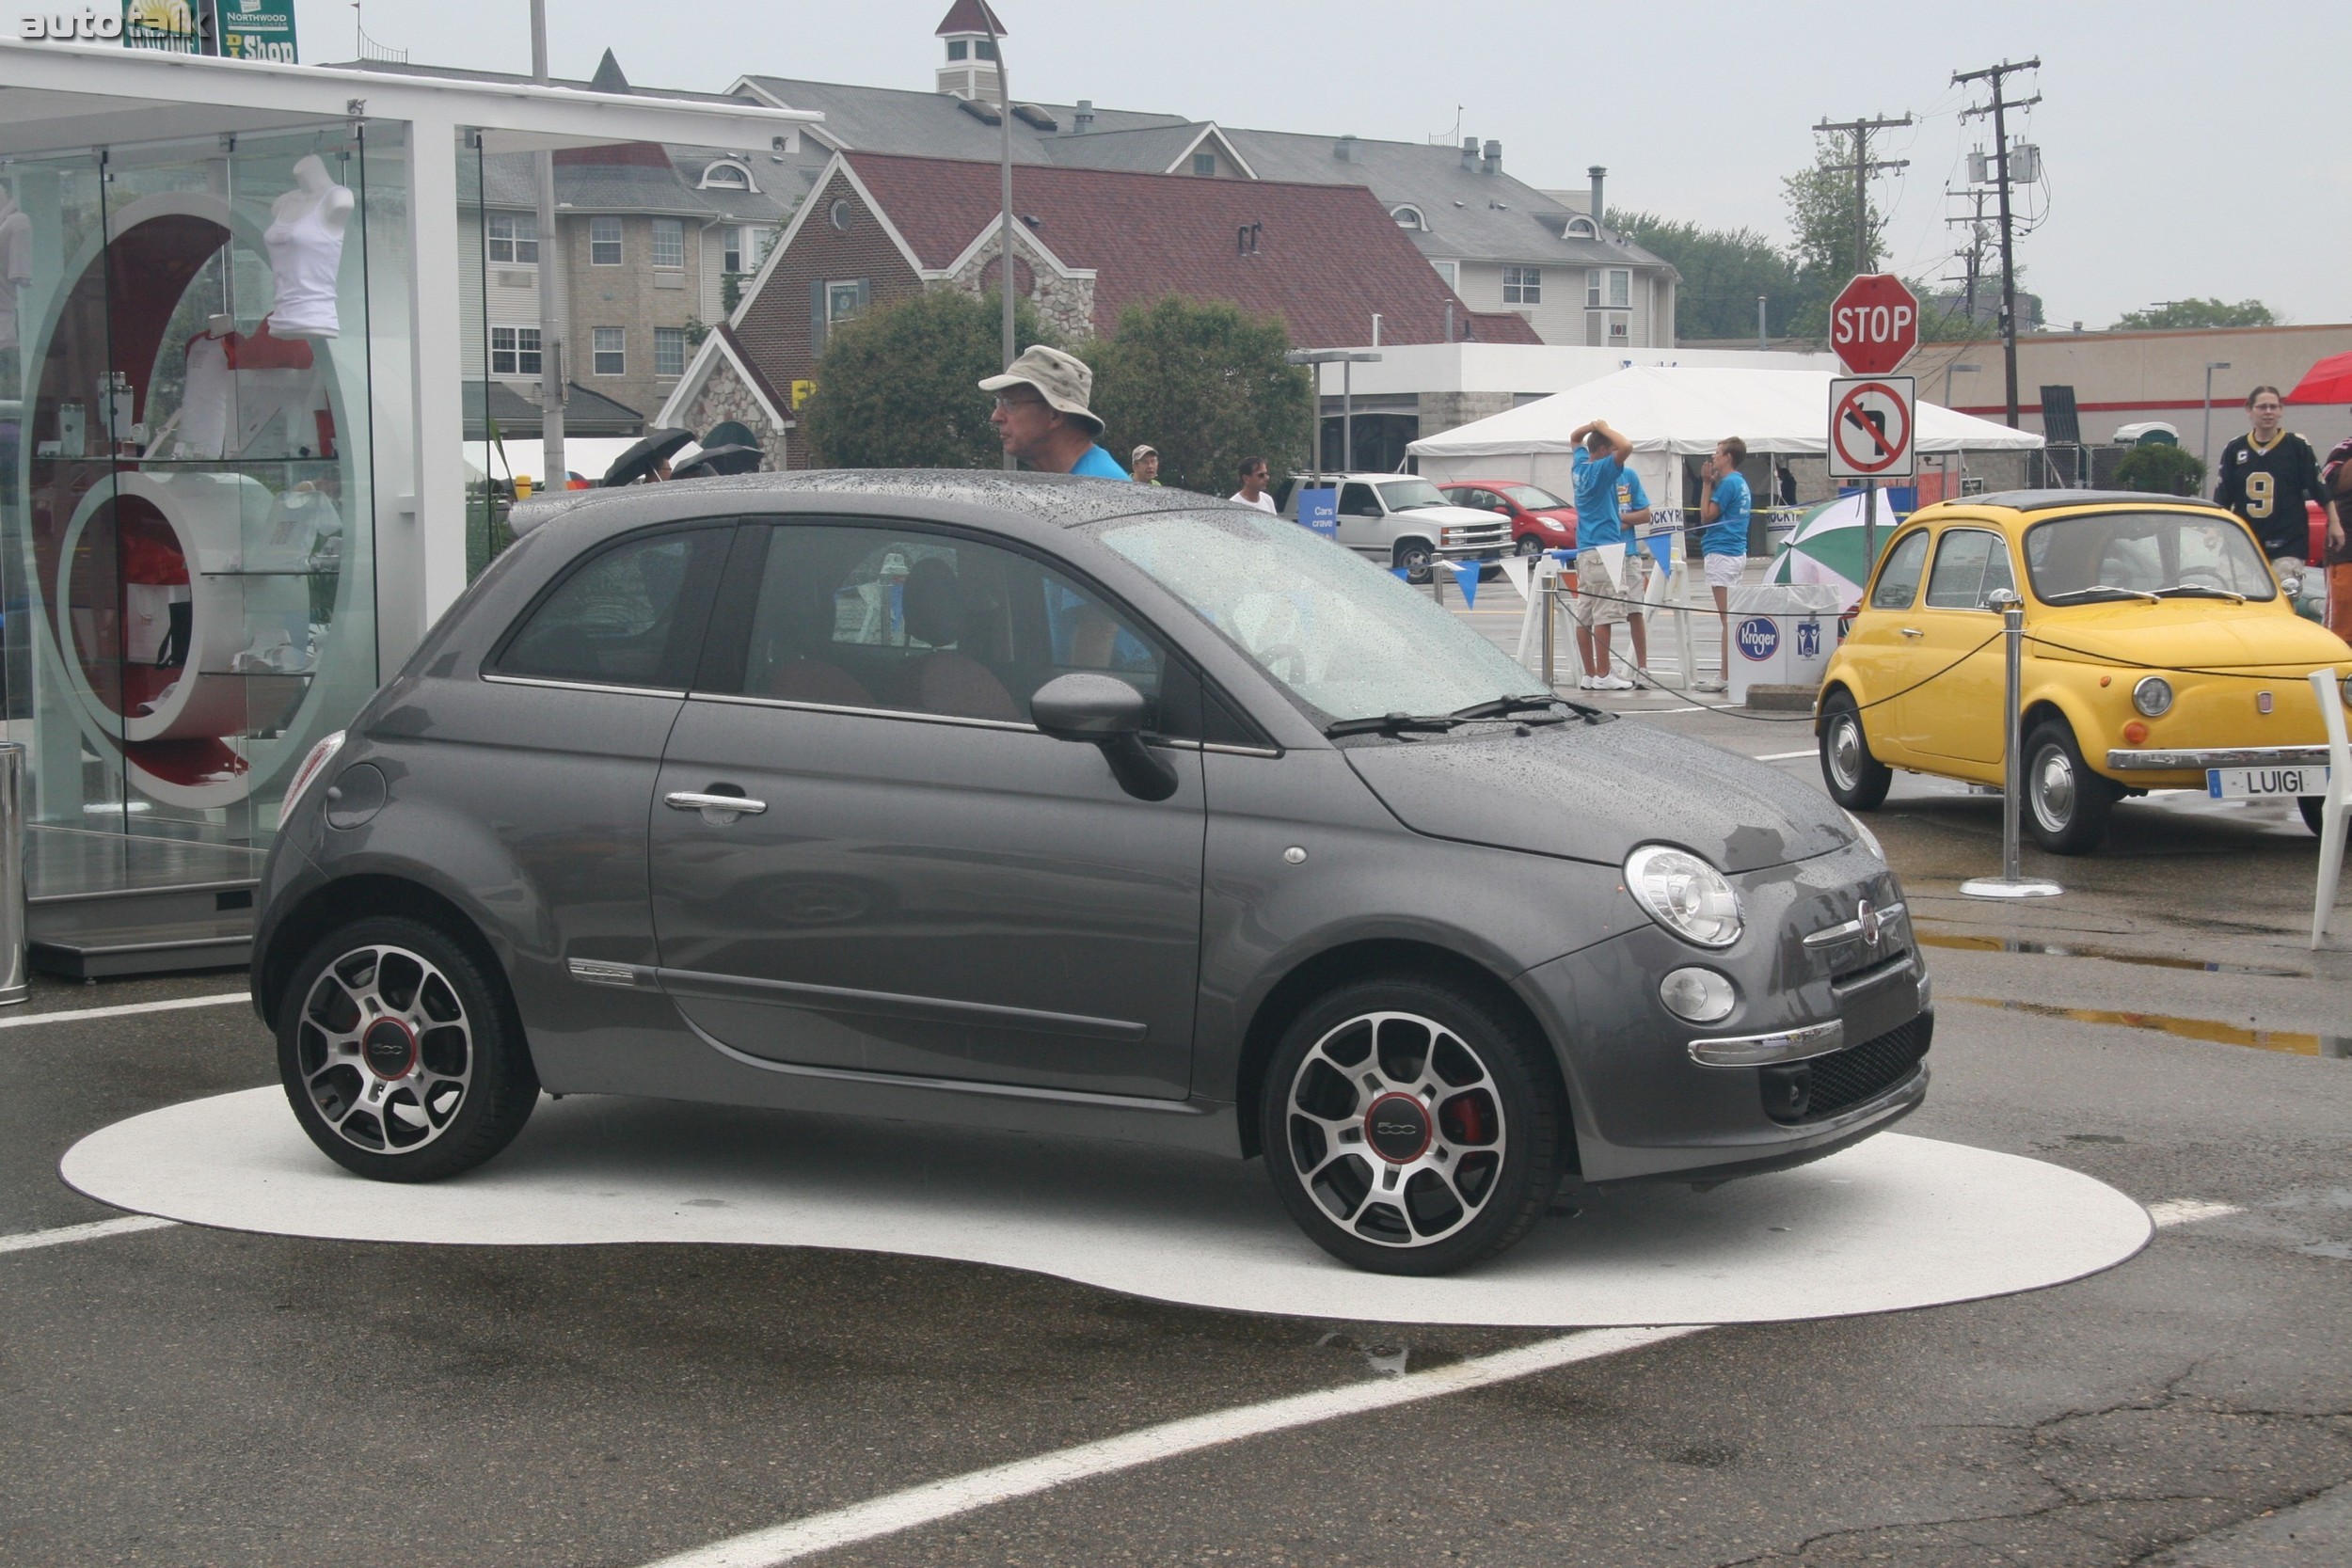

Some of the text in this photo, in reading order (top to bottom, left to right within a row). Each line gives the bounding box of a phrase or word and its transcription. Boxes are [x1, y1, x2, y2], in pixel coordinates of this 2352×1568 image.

[227, 12, 287, 23] NORTHWOOD
[243, 35, 294, 63] Shop
[1836, 305, 1912, 344] STOP
[2246, 471, 2275, 518] 9
[1314, 506, 1333, 516] Cars
[1311, 519, 1333, 528] crave
[1740, 621, 1776, 656] Kroger
[2247, 770, 2304, 794] LUIGI
[1376, 1121, 1417, 1135] 500
